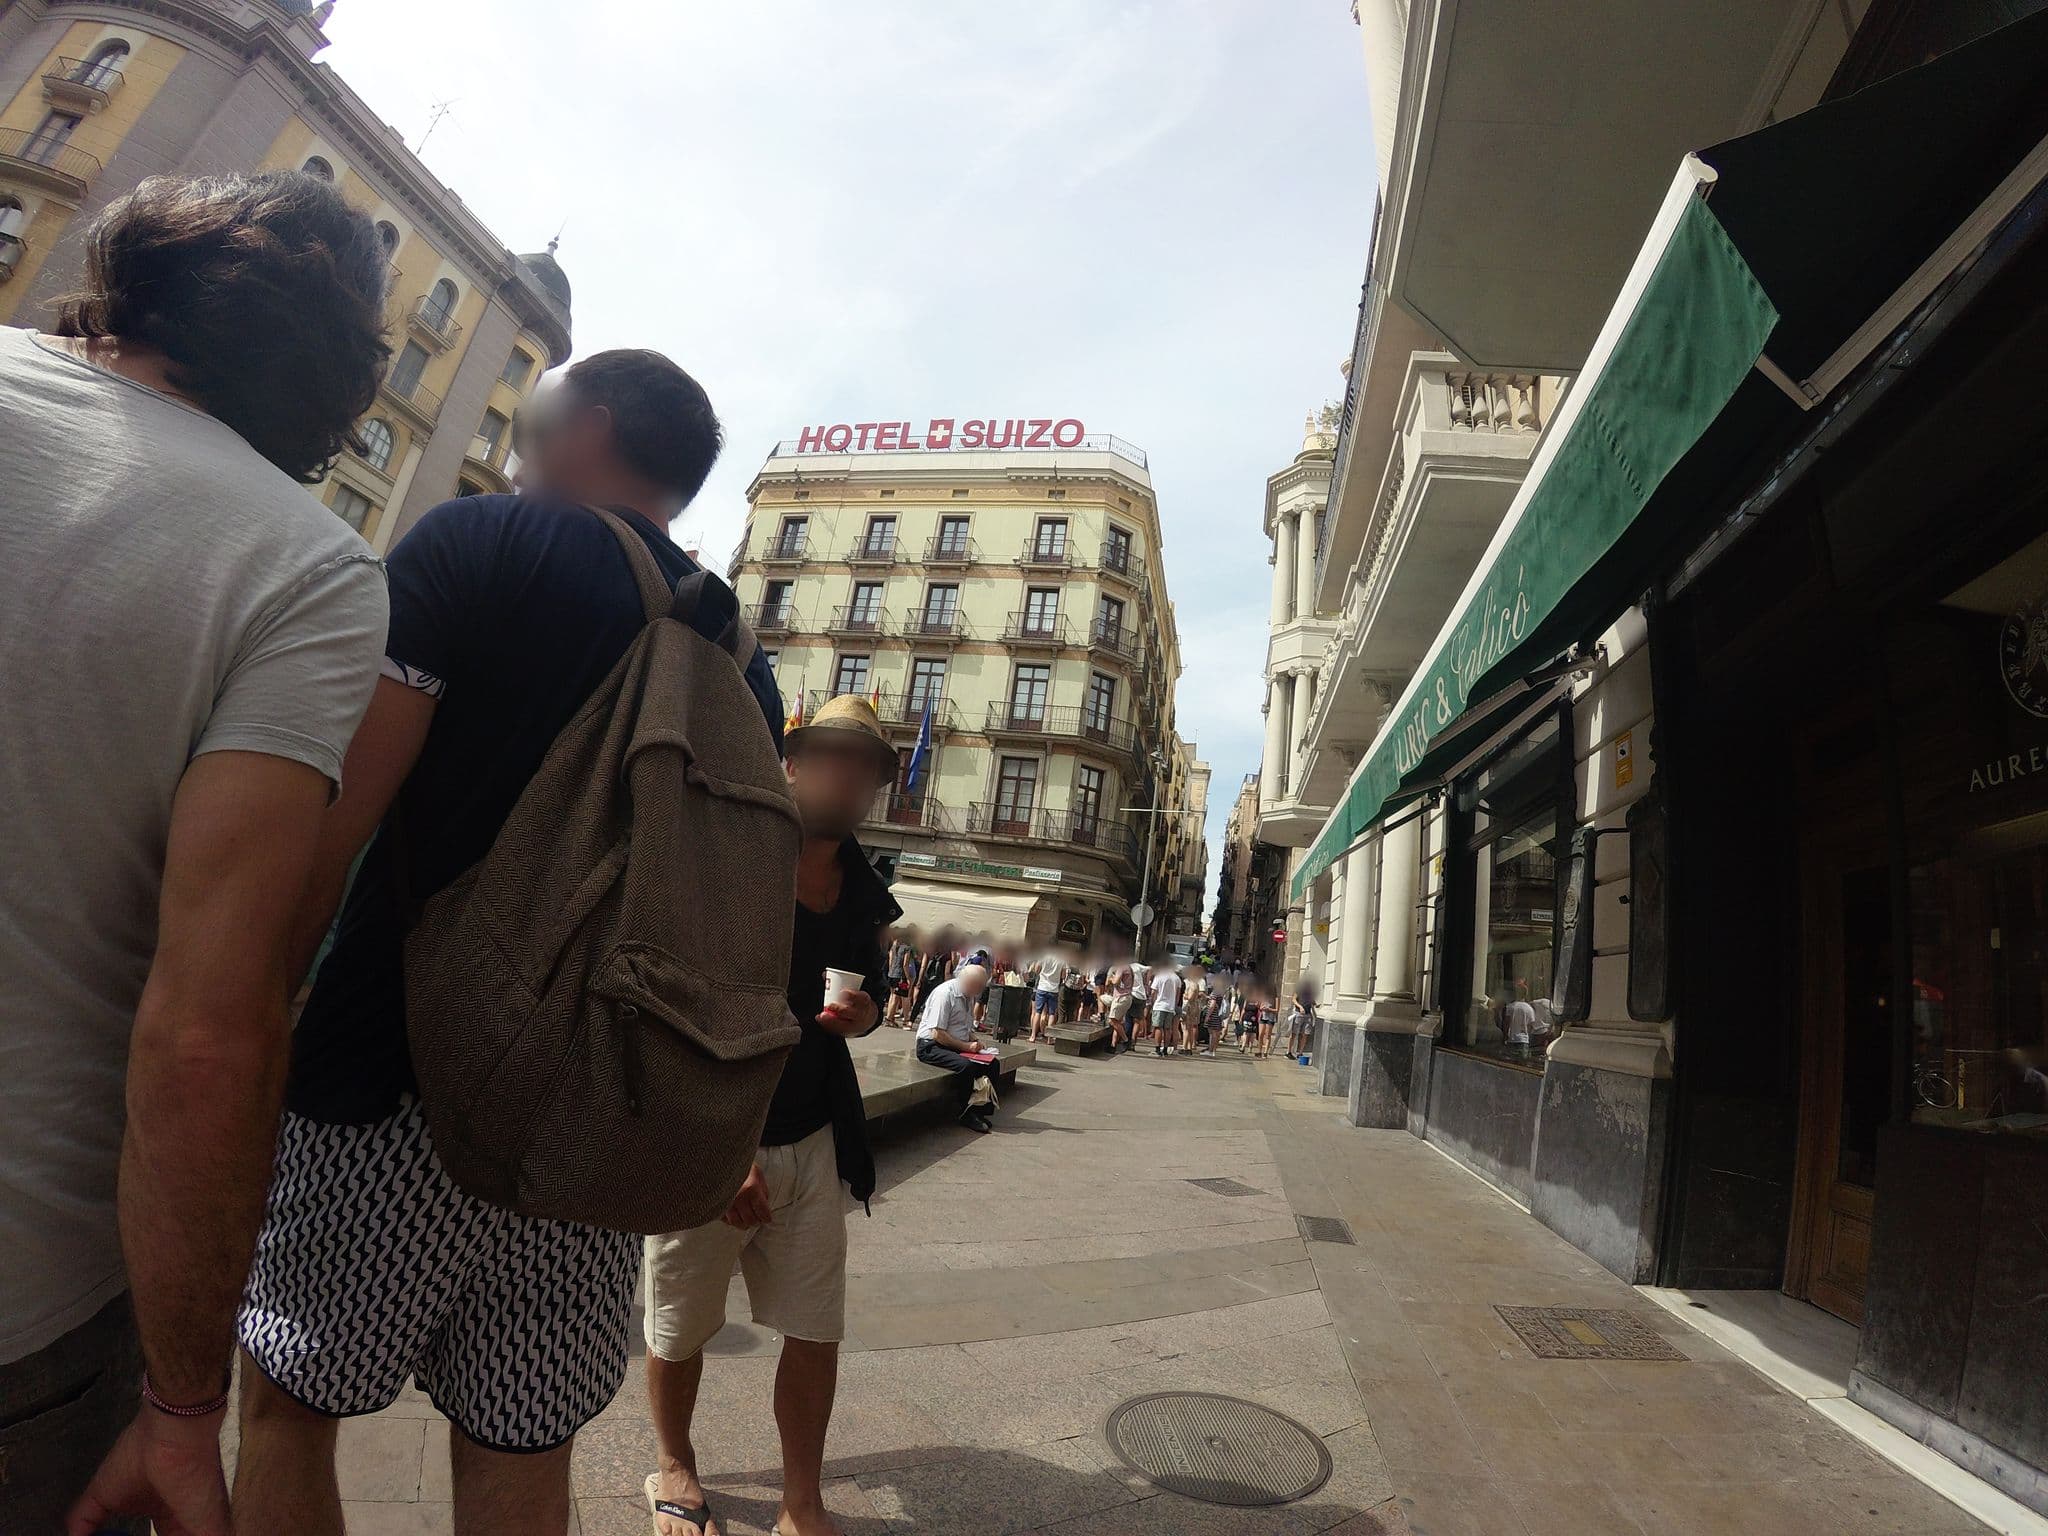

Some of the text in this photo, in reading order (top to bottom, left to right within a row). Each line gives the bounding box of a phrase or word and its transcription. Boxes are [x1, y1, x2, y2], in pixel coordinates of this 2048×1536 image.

[798, 419, 1085, 453] HOTEL SUIZO
[1436, 676, 1452, 725] &
[1969, 746, 2048, 792] AURE
